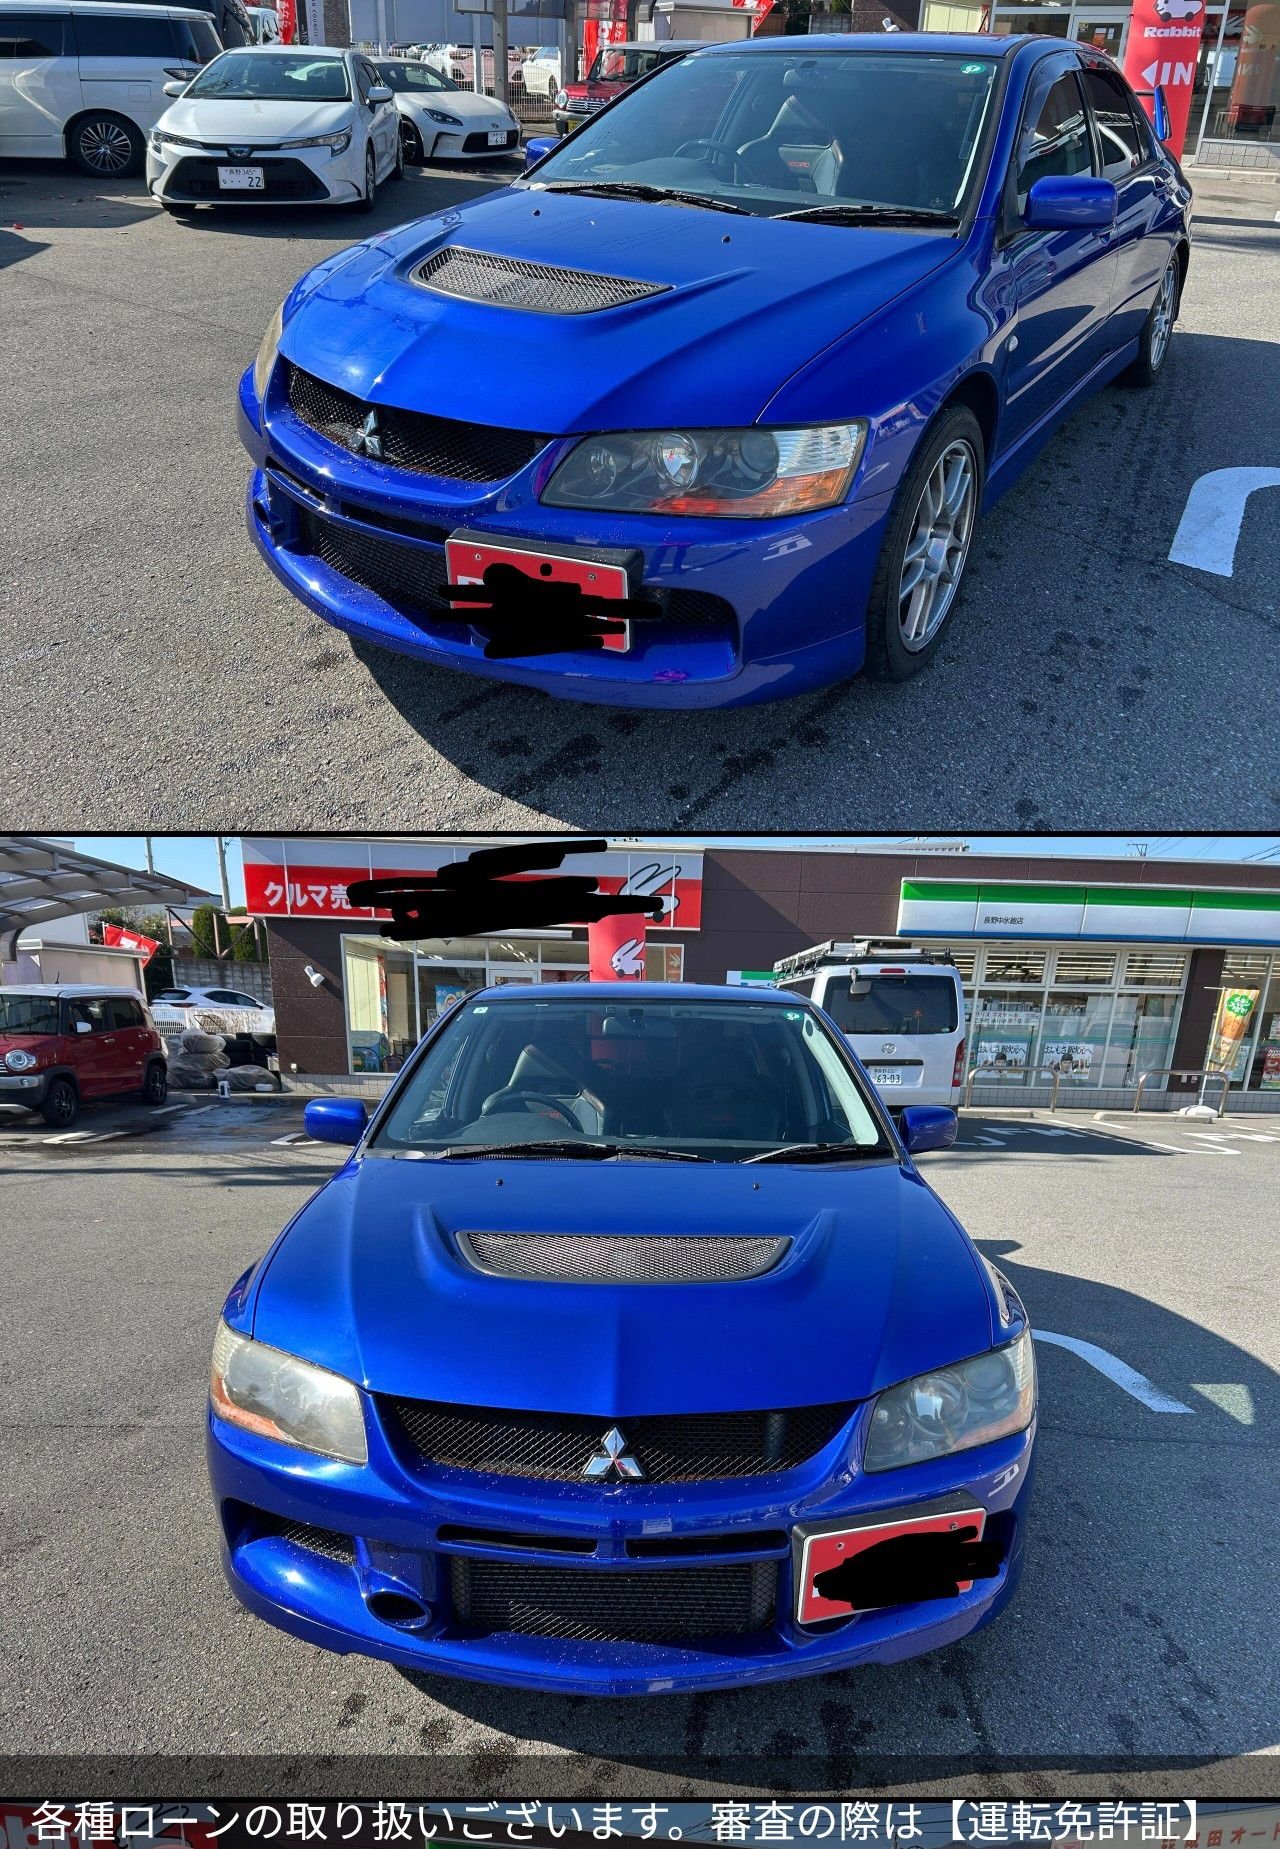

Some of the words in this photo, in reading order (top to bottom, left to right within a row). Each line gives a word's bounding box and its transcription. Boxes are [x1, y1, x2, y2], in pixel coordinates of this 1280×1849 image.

[1144, 26, 1201, 38] Rabbit
[1159, 62, 1194, 86] IN
[248, 176, 262, 188] 22
[877, 1074, 901, 1083] 63-03
